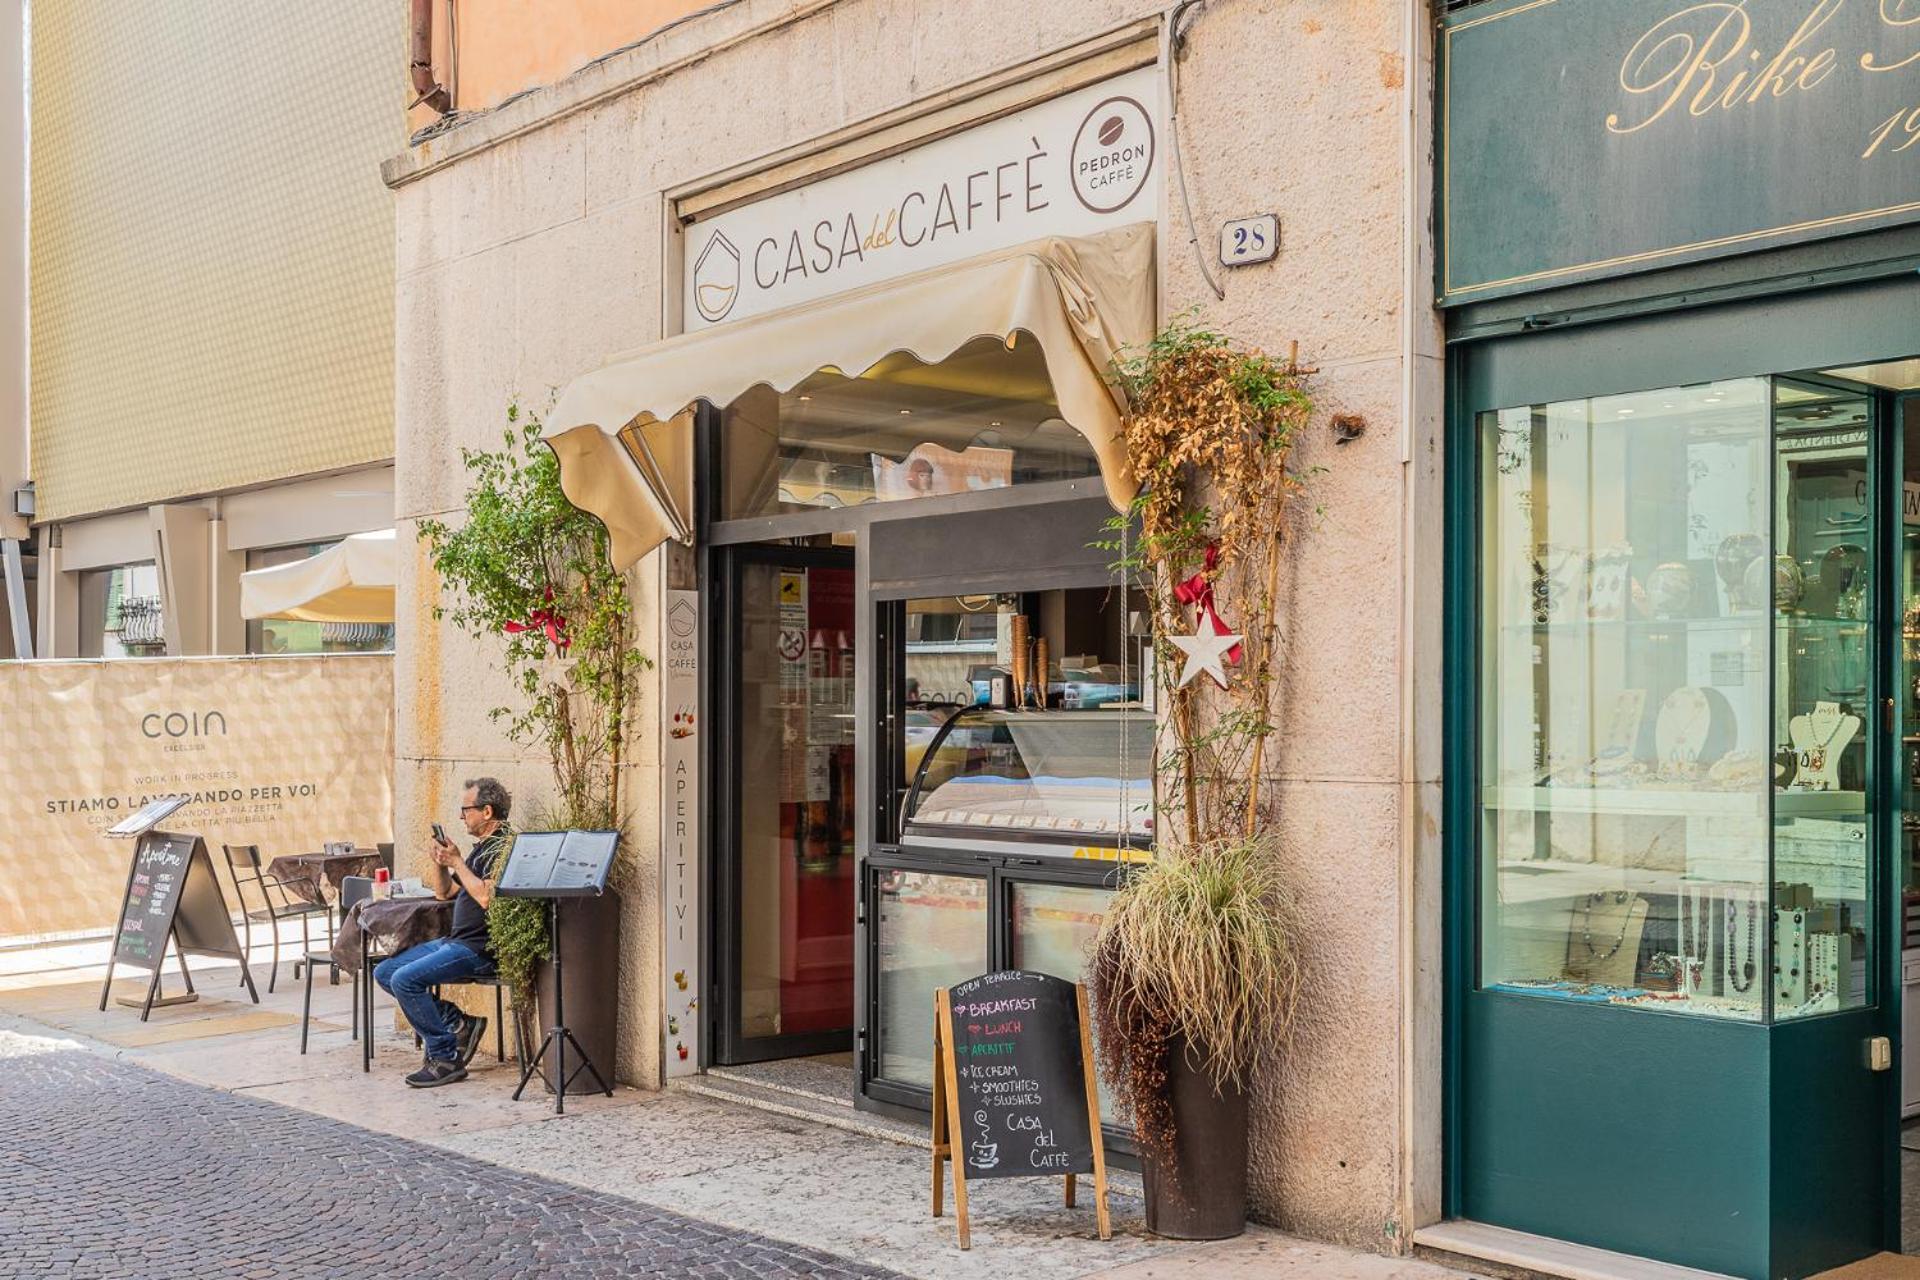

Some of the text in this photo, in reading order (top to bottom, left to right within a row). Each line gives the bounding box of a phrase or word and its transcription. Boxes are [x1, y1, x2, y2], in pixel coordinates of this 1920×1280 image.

[1606, 0, 1843, 133] Rike
[1080, 144, 1144, 175] PEDRON
[1090, 164, 1134, 189] CAFFÈ
[754, 136, 1049, 289] CASA del CAFFÈ
[1233, 223, 1265, 255] 28
[670, 640, 694, 651] CASA
[141, 711, 227, 738] COIN
[135, 775, 167, 784] WORK
[185, 771, 238, 781] PROGRESS
[46, 797, 119, 813] STIAMO
[250, 787, 281, 800] PER
[675, 759, 687, 941] APERITIVI
[957, 980, 980, 996] OPEN
[969, 998, 1037, 1017] BREAKFAST
[983, 1020, 1021, 1035] LUNCH
[985, 1065, 1018, 1078] CREAM
